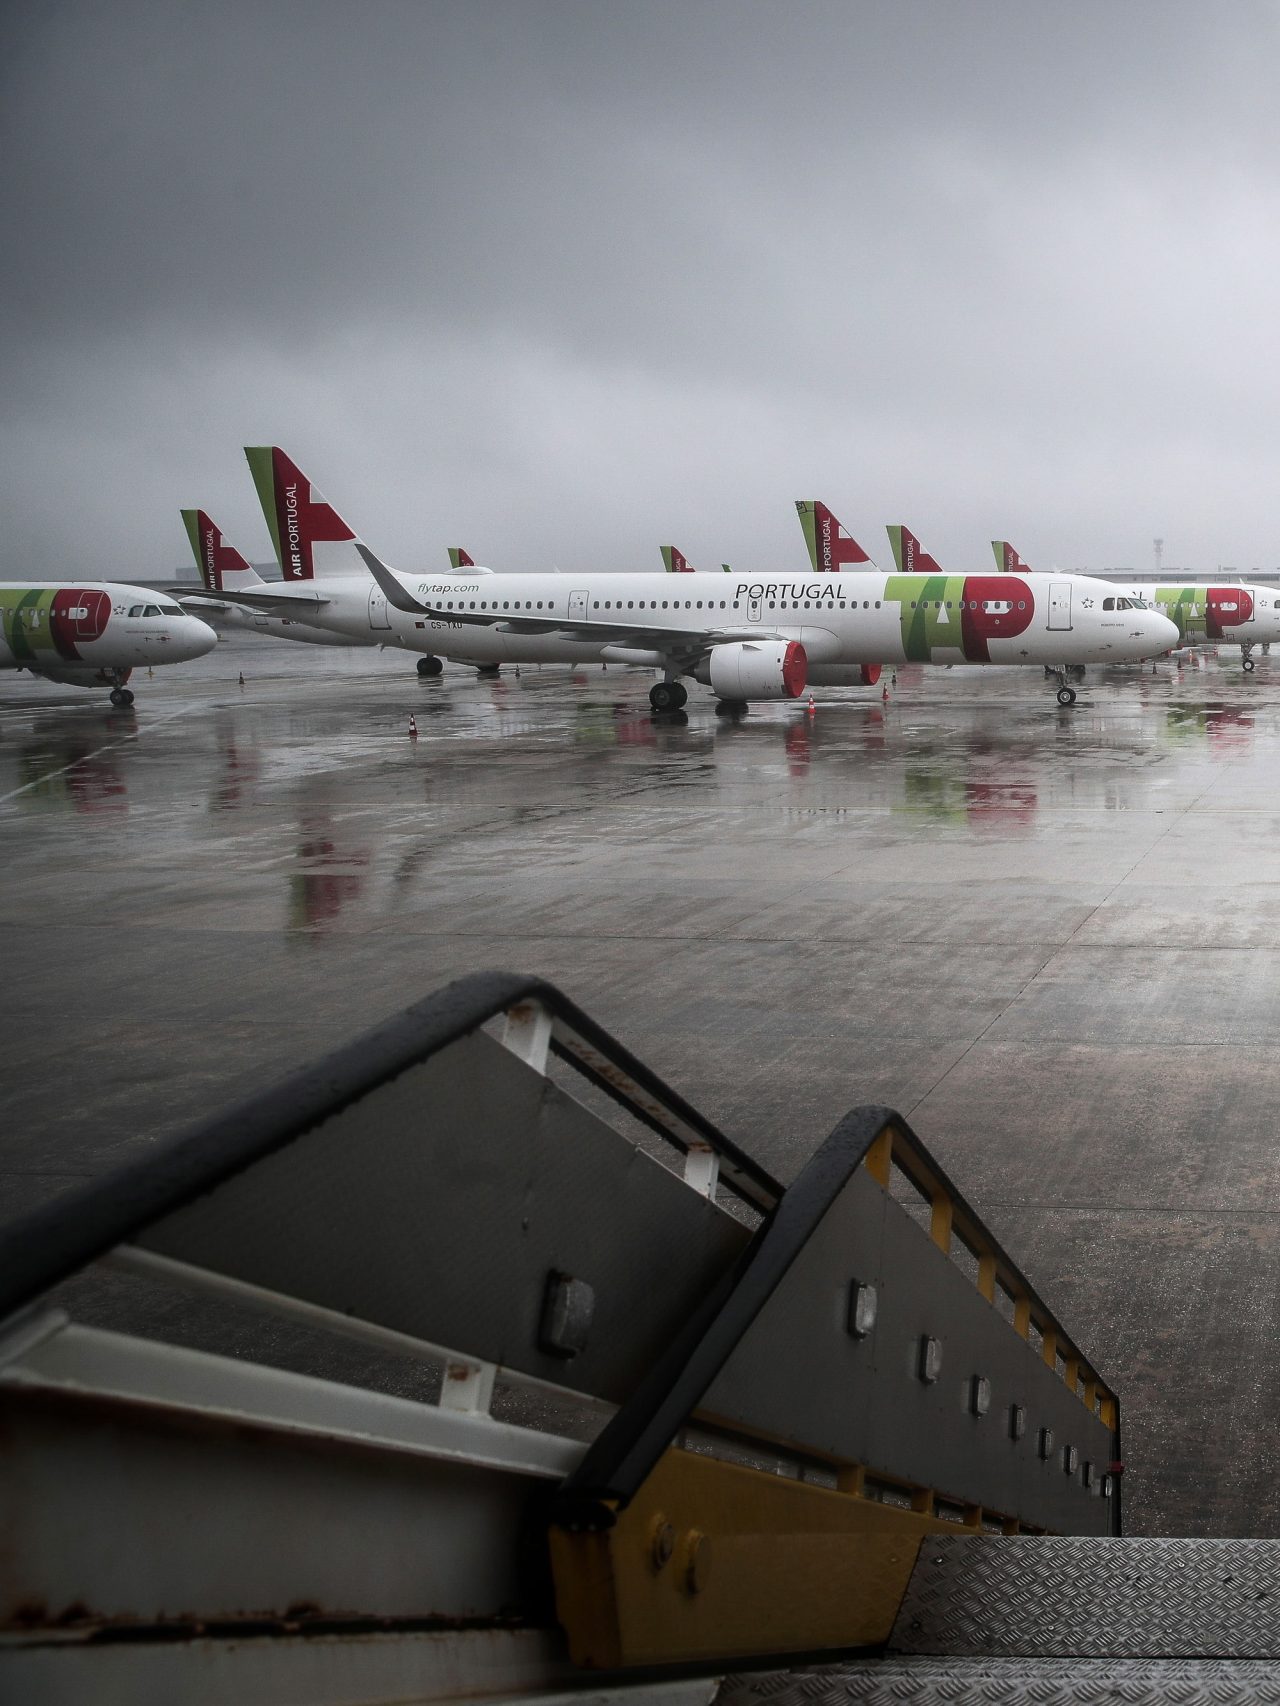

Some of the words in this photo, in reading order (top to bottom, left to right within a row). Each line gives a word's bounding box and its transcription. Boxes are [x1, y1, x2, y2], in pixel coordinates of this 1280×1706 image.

[286, 482, 300, 553] PORTUGAL
[206, 528, 215, 575] PORTUGAL
[292, 554, 302, 577] AIR
[822, 517, 832, 567] PORTUGAL
[417, 583, 480, 594] flytap.com
[735, 584, 847, 599] PORTUGAL
[883, 576, 1035, 662] TAP
[1155, 588, 1253, 639] TAP
